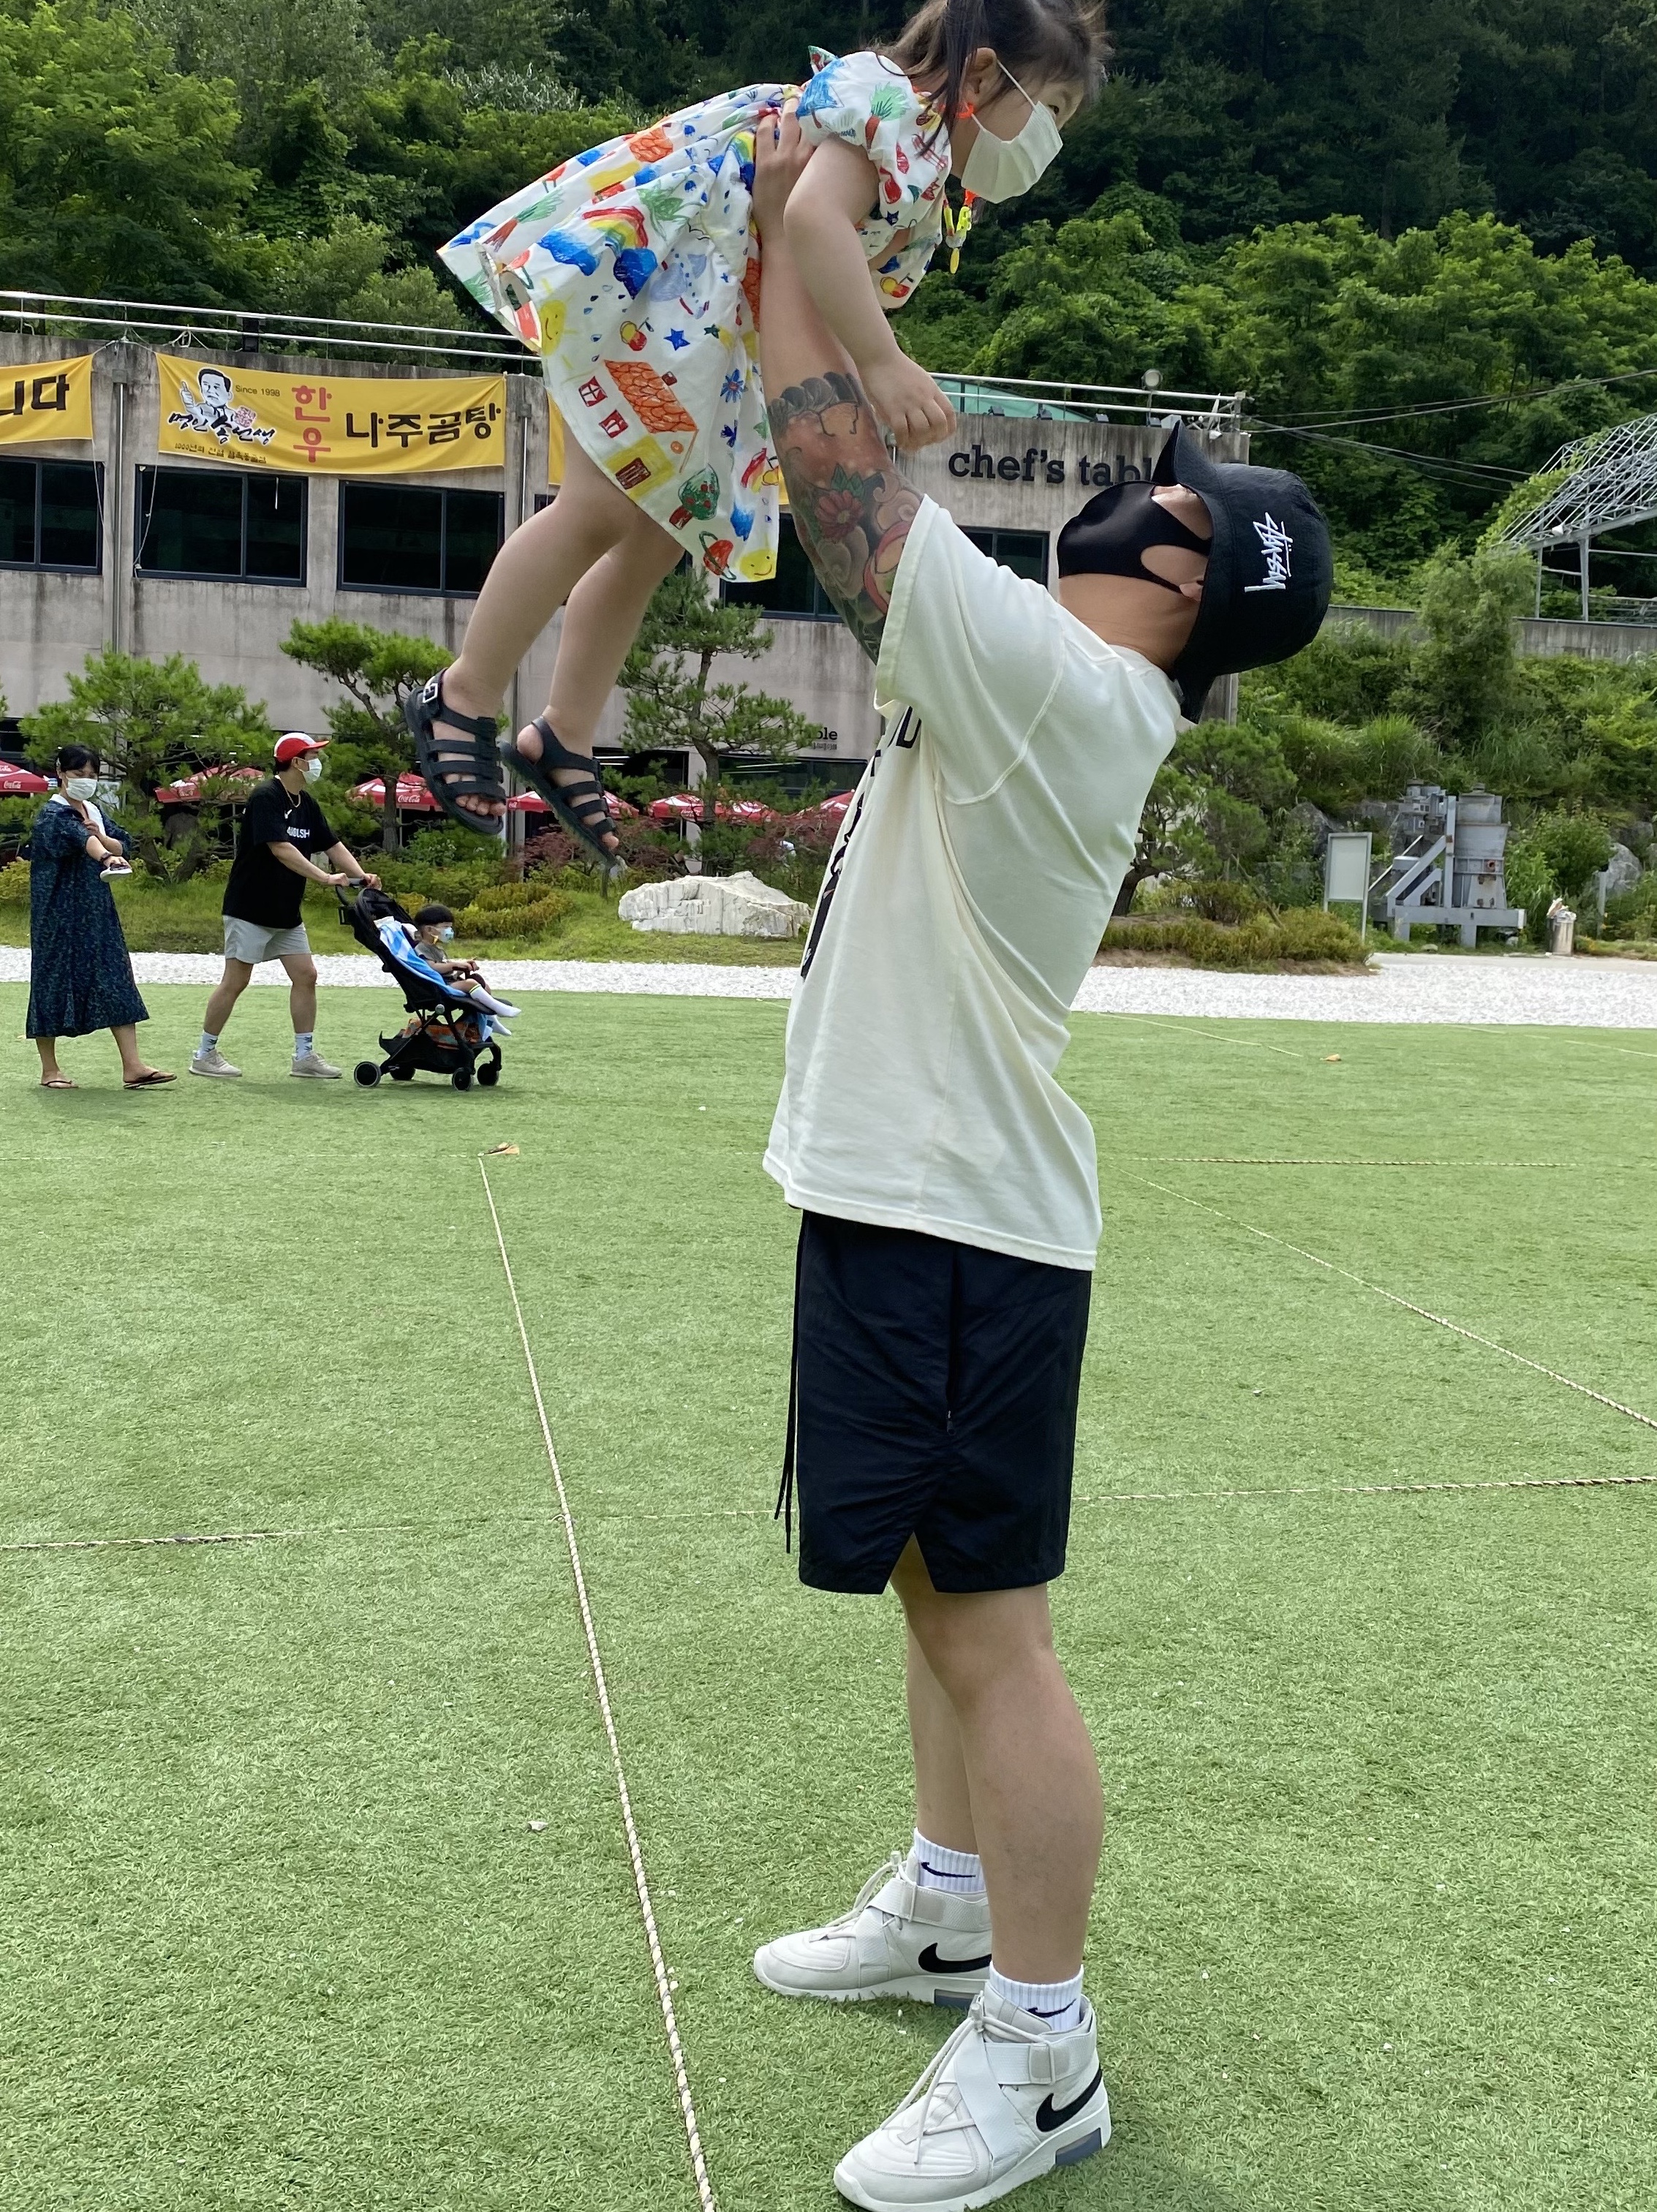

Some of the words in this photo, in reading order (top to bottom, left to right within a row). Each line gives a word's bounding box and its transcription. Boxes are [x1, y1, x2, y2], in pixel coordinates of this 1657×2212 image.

[235, 385, 257, 394] Since
[292, 385, 332, 463] 한우
[346, 403, 501, 448] 나주곰탕
[948, 445, 1065, 483] chef's
[1079, 455, 1152, 486] tabl
